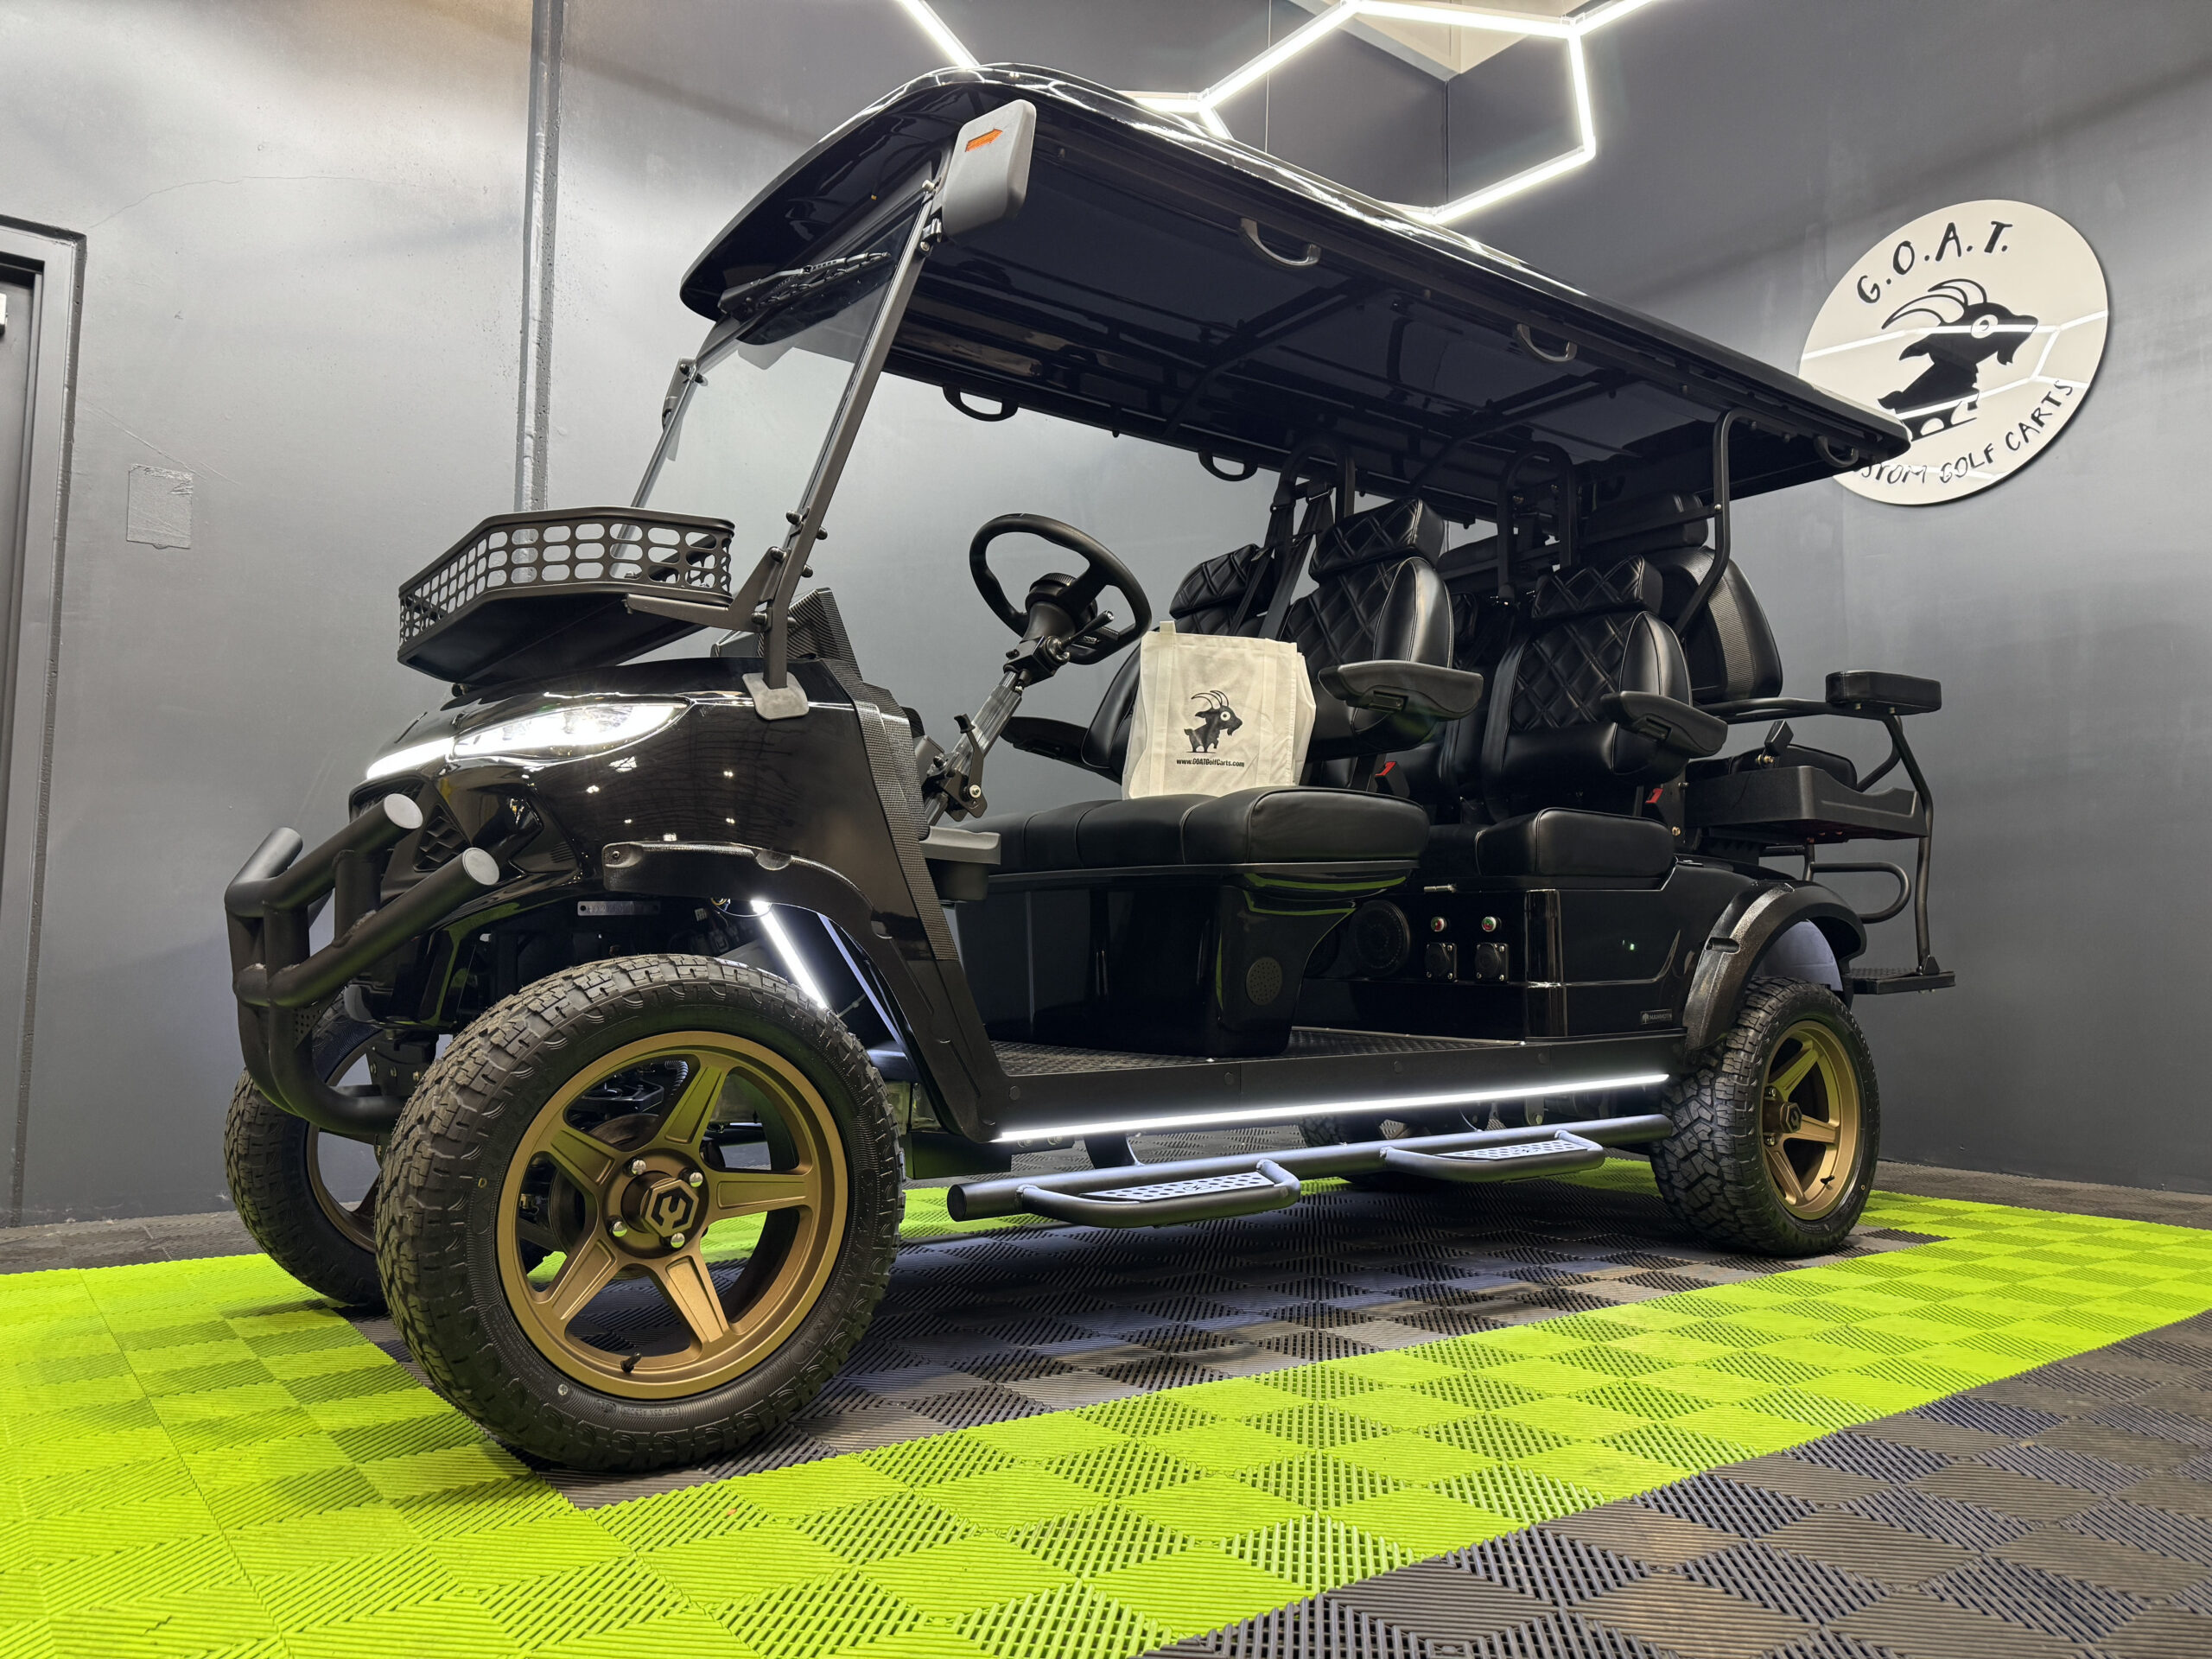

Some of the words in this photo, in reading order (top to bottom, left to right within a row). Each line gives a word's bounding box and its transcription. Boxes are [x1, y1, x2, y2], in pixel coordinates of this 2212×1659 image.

[1857, 220, 2014, 304] G.O.A.T.
[1859, 463, 1928, 485] STOM
[1940, 442, 1994, 484] GOLF
[2005, 379, 2073, 451] CARTS
[1176, 758, 1245, 767] www.GOATGolfCarts.com
